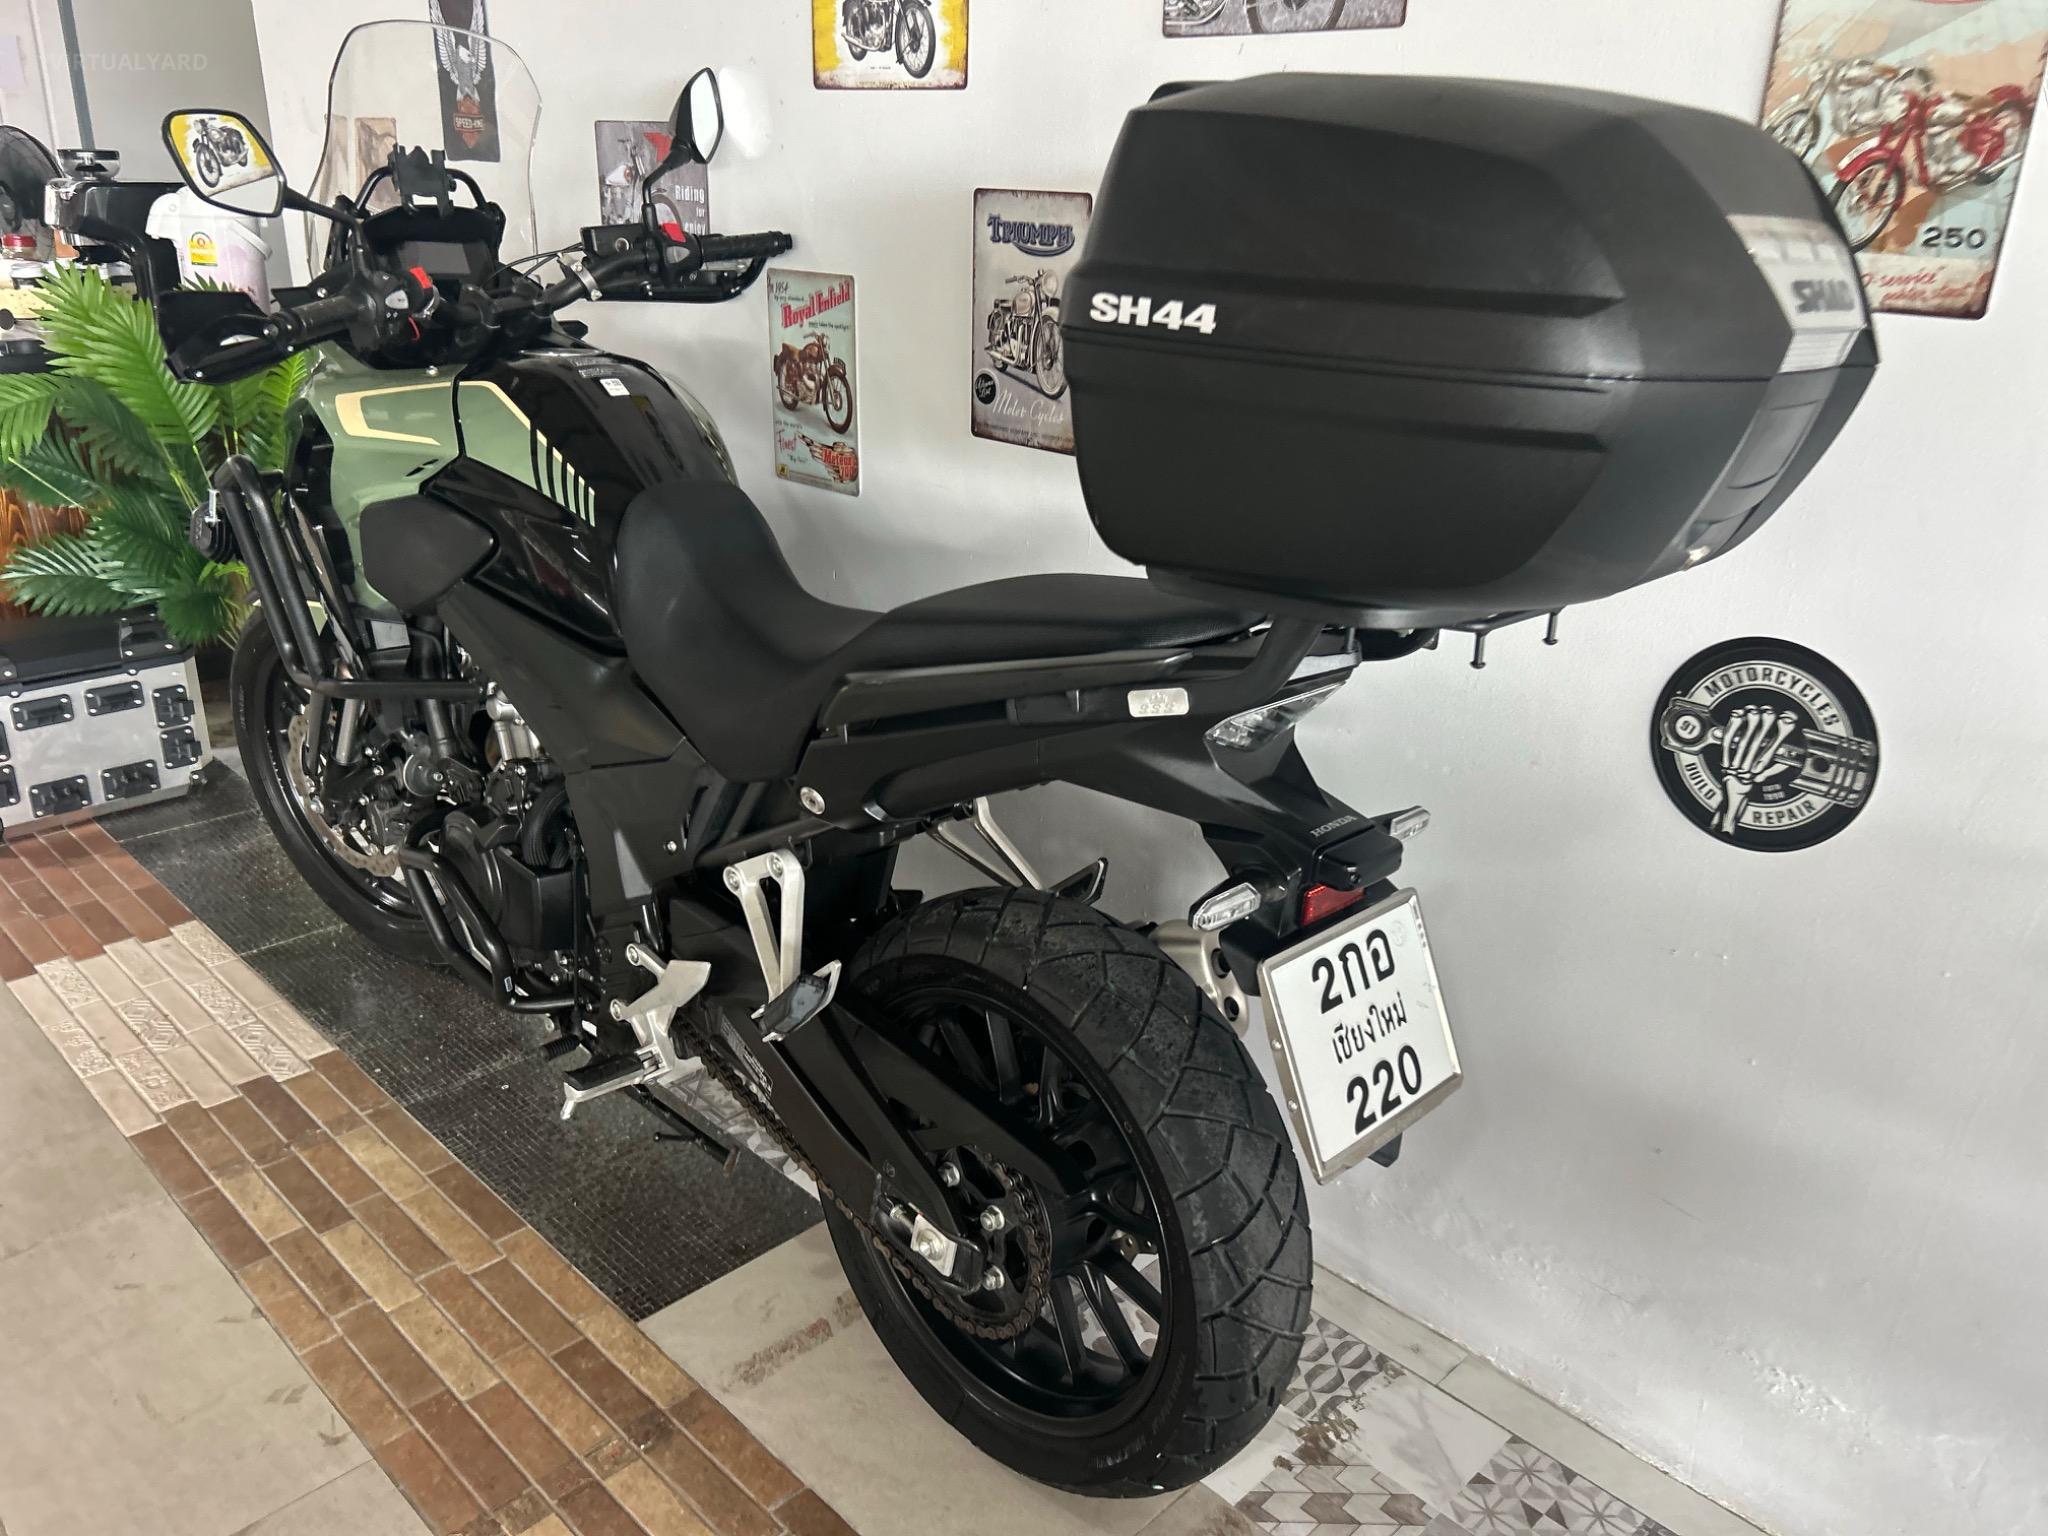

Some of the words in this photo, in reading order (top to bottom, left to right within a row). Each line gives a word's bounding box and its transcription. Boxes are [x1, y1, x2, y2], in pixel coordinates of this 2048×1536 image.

[675, 184, 705, 204] Riding
[986, 212, 1074, 248] TRIUMPH
[1921, 225, 1987, 250] 250
[780, 291, 816, 329] Royal
[815, 280, 851, 314] Enfield
[1089, 291, 1217, 335] SH44
[1703, 666, 1840, 727] MOTORCYCLES
[1684, 762, 1717, 801] BUILD
[1309, 815, 1358, 837] HONDA
[1753, 801, 1817, 825] REPAIR
[1311, 928, 1396, 1015] 2กอ
[1332, 991, 1408, 1065] เชียงใหม่
[1346, 1044, 1422, 1136] 220
